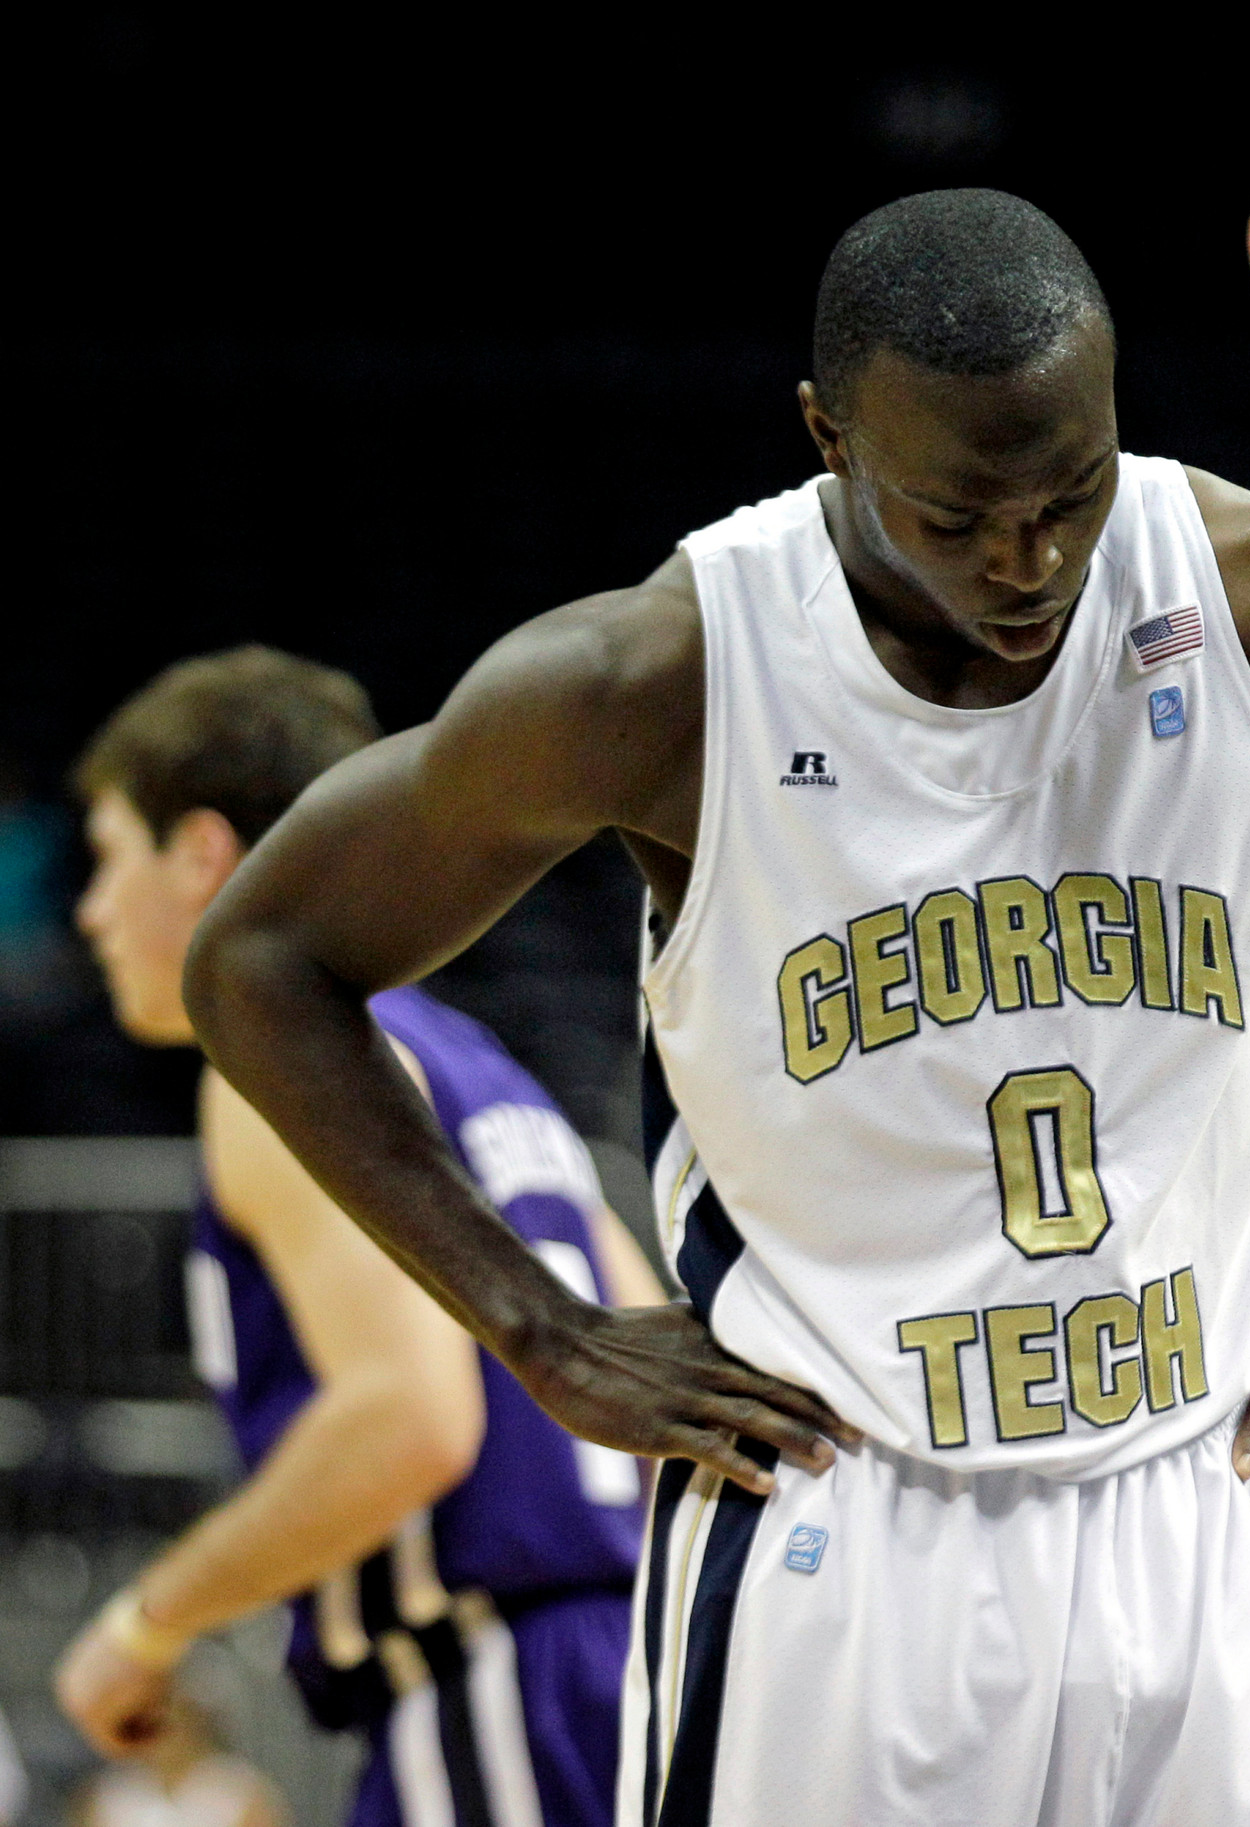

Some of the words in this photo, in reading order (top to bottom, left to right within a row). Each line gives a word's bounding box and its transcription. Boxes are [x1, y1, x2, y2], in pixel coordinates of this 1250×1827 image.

[780, 775, 839, 787] RUSSELL
[791, 751, 827, 774] R
[775, 871, 1246, 1085] GEORGIA
[986, 1065, 1112, 1260] 0
[897, 1264, 1210, 1449] TECH
